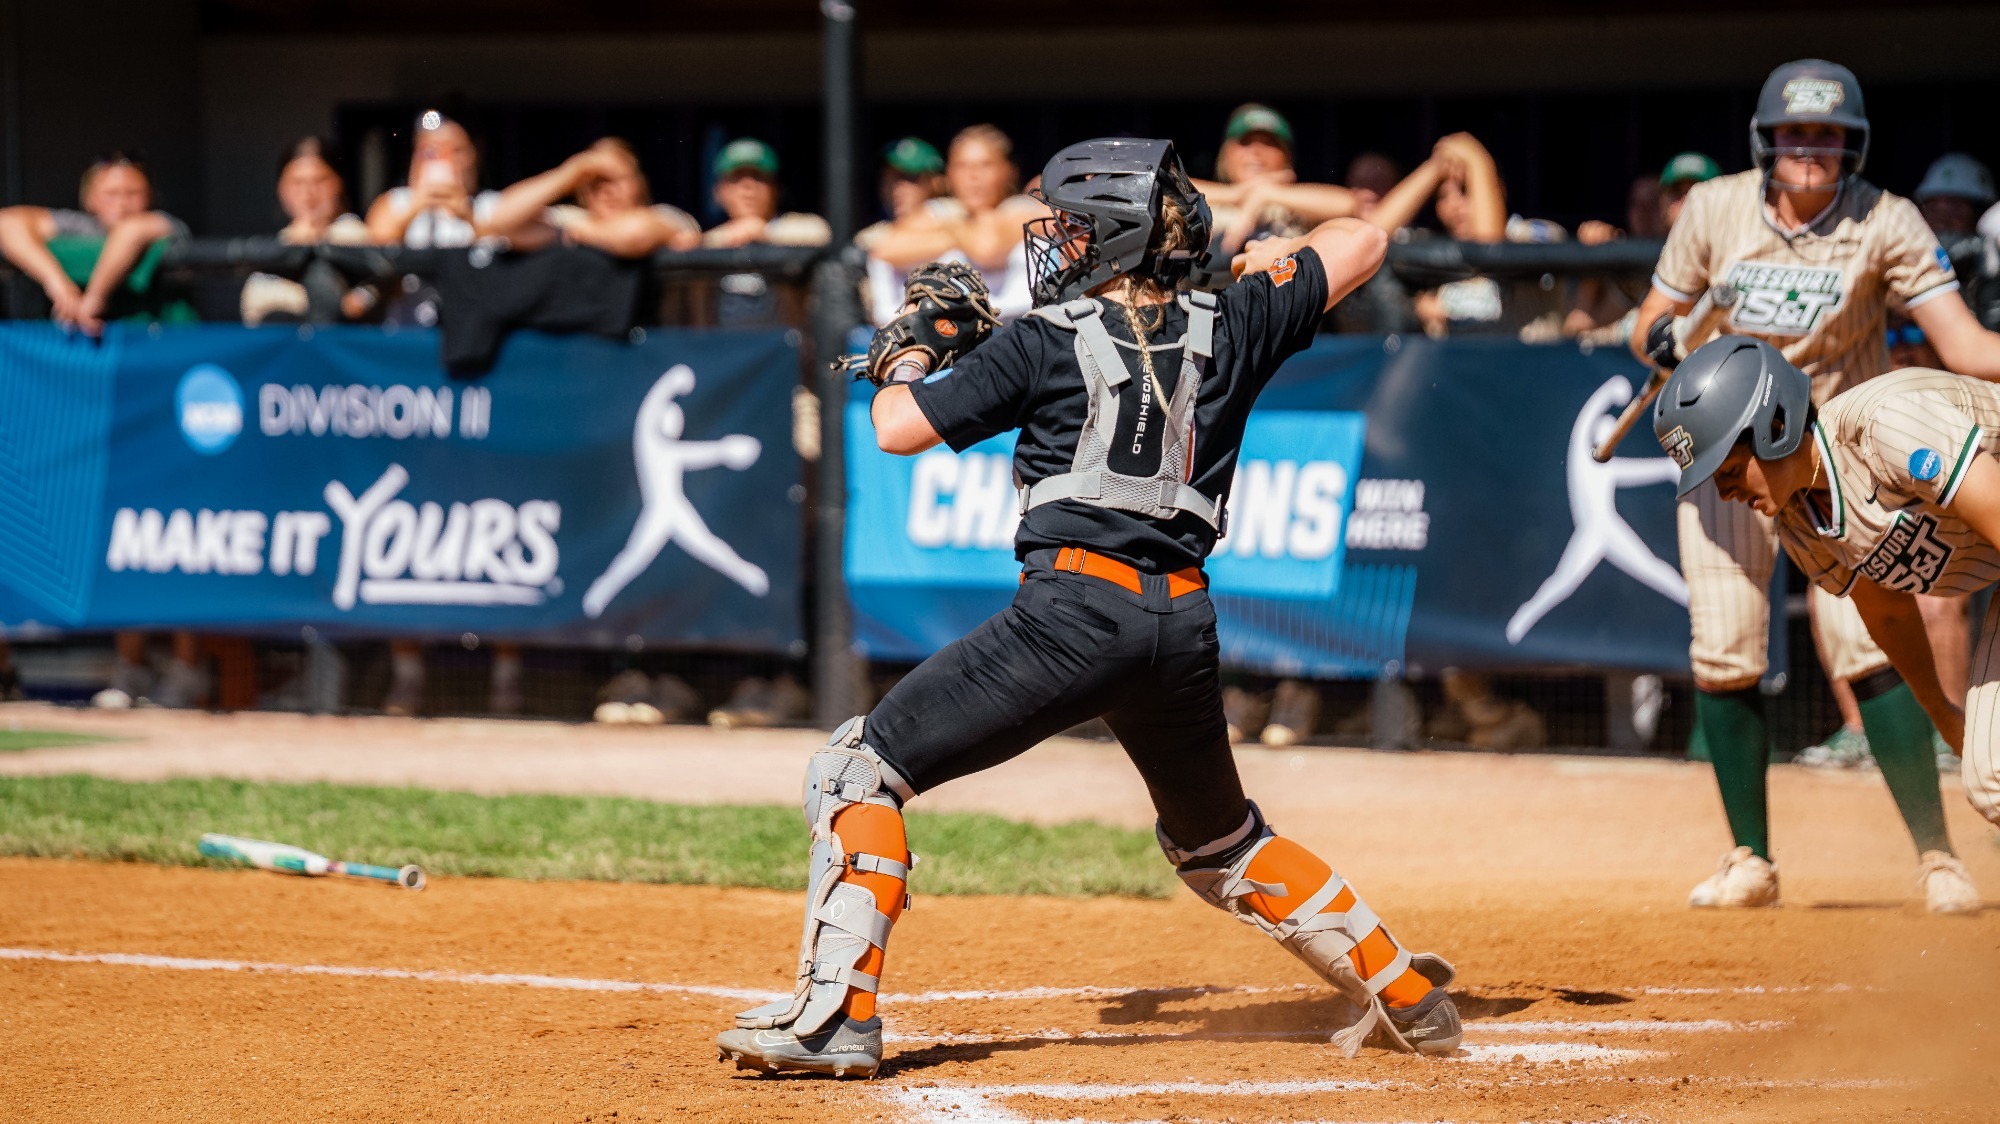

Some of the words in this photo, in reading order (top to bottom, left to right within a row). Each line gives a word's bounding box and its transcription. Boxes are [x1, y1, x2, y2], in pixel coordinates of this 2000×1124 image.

[1736, 289, 1841, 329] S&T
[259, 383, 453, 439] DIVISION
[1355, 479, 1425, 511] WIN
[107, 508, 268, 575] MAKE
[269, 511, 331, 576] IT
[323, 463, 561, 611] YOURS
[1344, 511, 1430, 550] HERE
